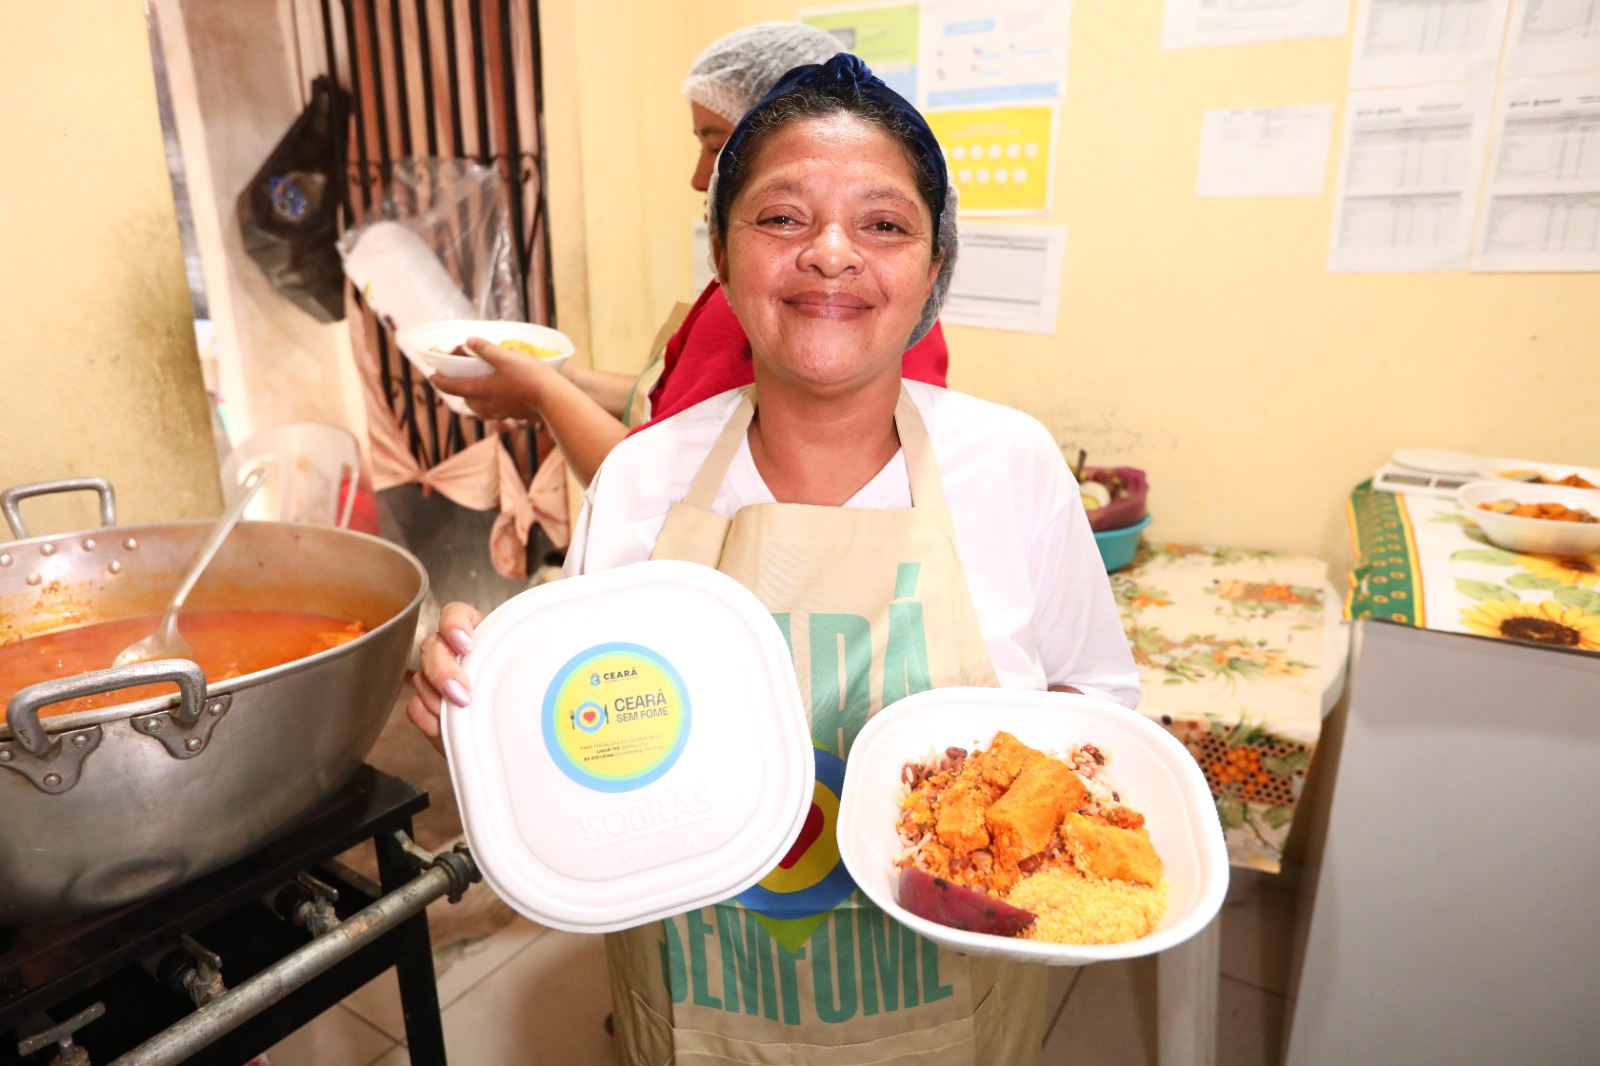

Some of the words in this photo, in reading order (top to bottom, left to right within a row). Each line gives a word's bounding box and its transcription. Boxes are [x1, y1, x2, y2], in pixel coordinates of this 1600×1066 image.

[603, 667, 638, 681] CEARÁ
[614, 689, 667, 712] CEARÁ
[616, 711, 639, 723] SEM
[640, 706, 669, 718] FOME
